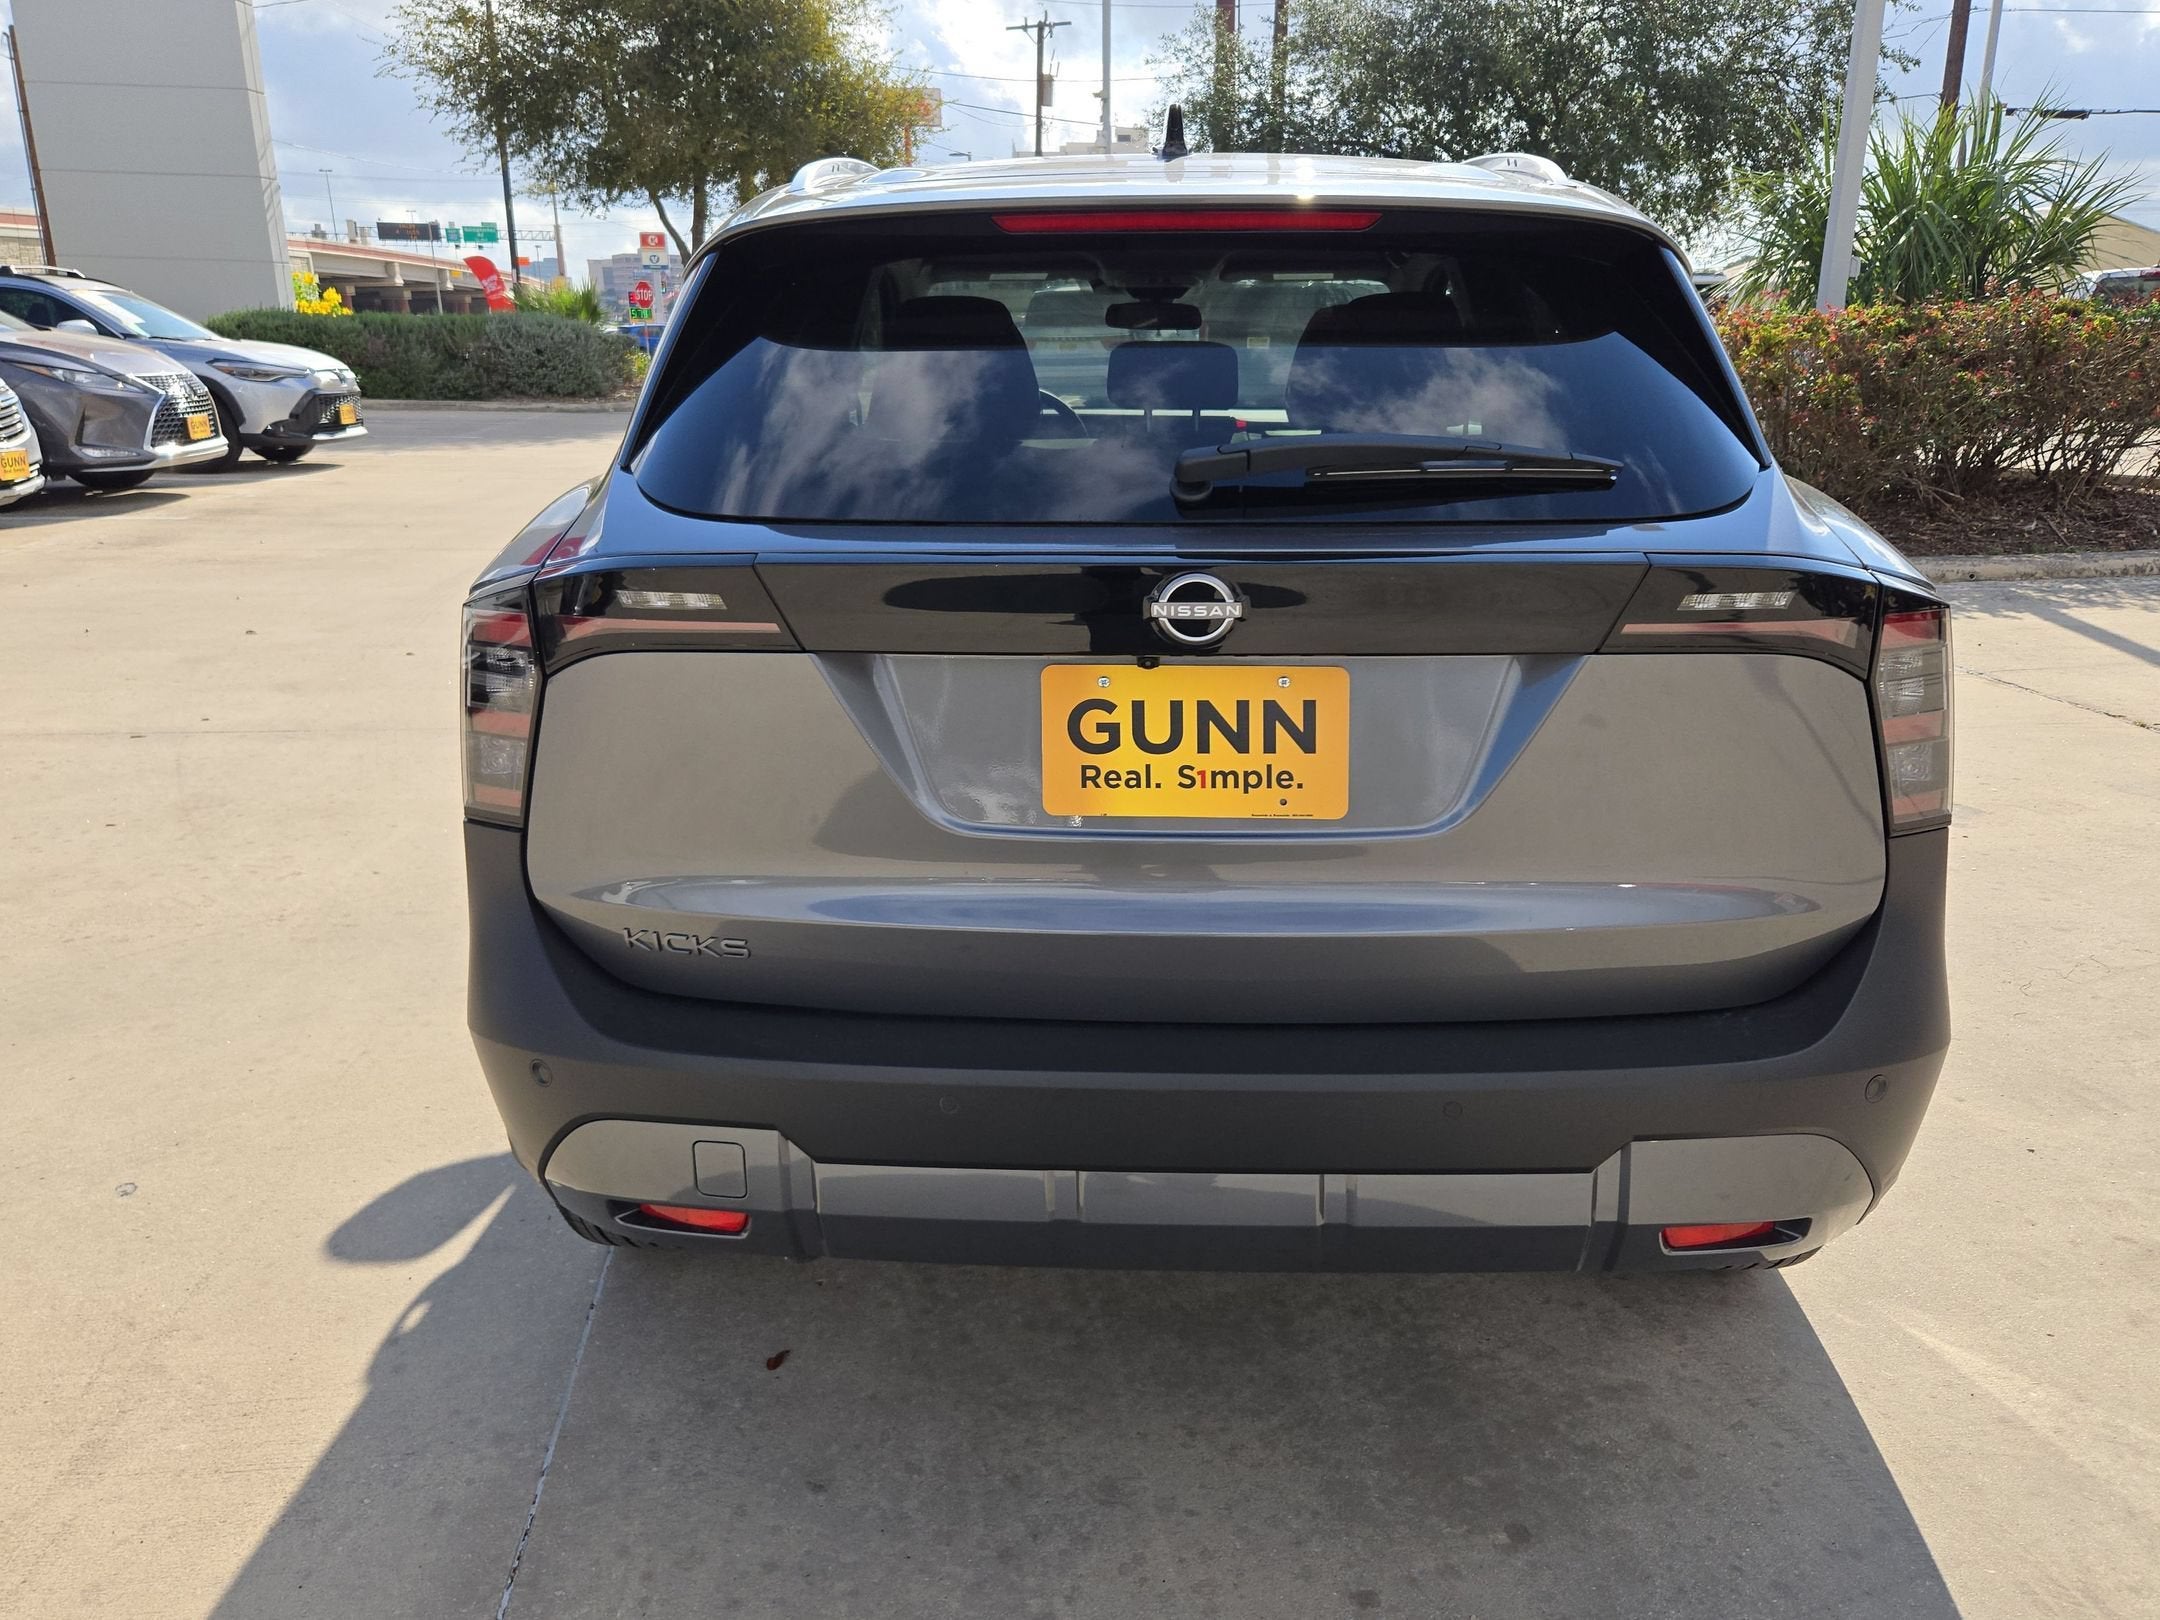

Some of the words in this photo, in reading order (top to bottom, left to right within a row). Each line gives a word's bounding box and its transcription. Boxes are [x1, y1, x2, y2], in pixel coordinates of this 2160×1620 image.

[636, 289, 653, 301] STOP
[1, 456, 26, 468] GUNN
[1153, 605, 1241, 617] NISSAN
[1066, 698, 1317, 755] GUNN
[1080, 763, 1162, 789] Real.
[623, 927, 752, 959] KICKS
